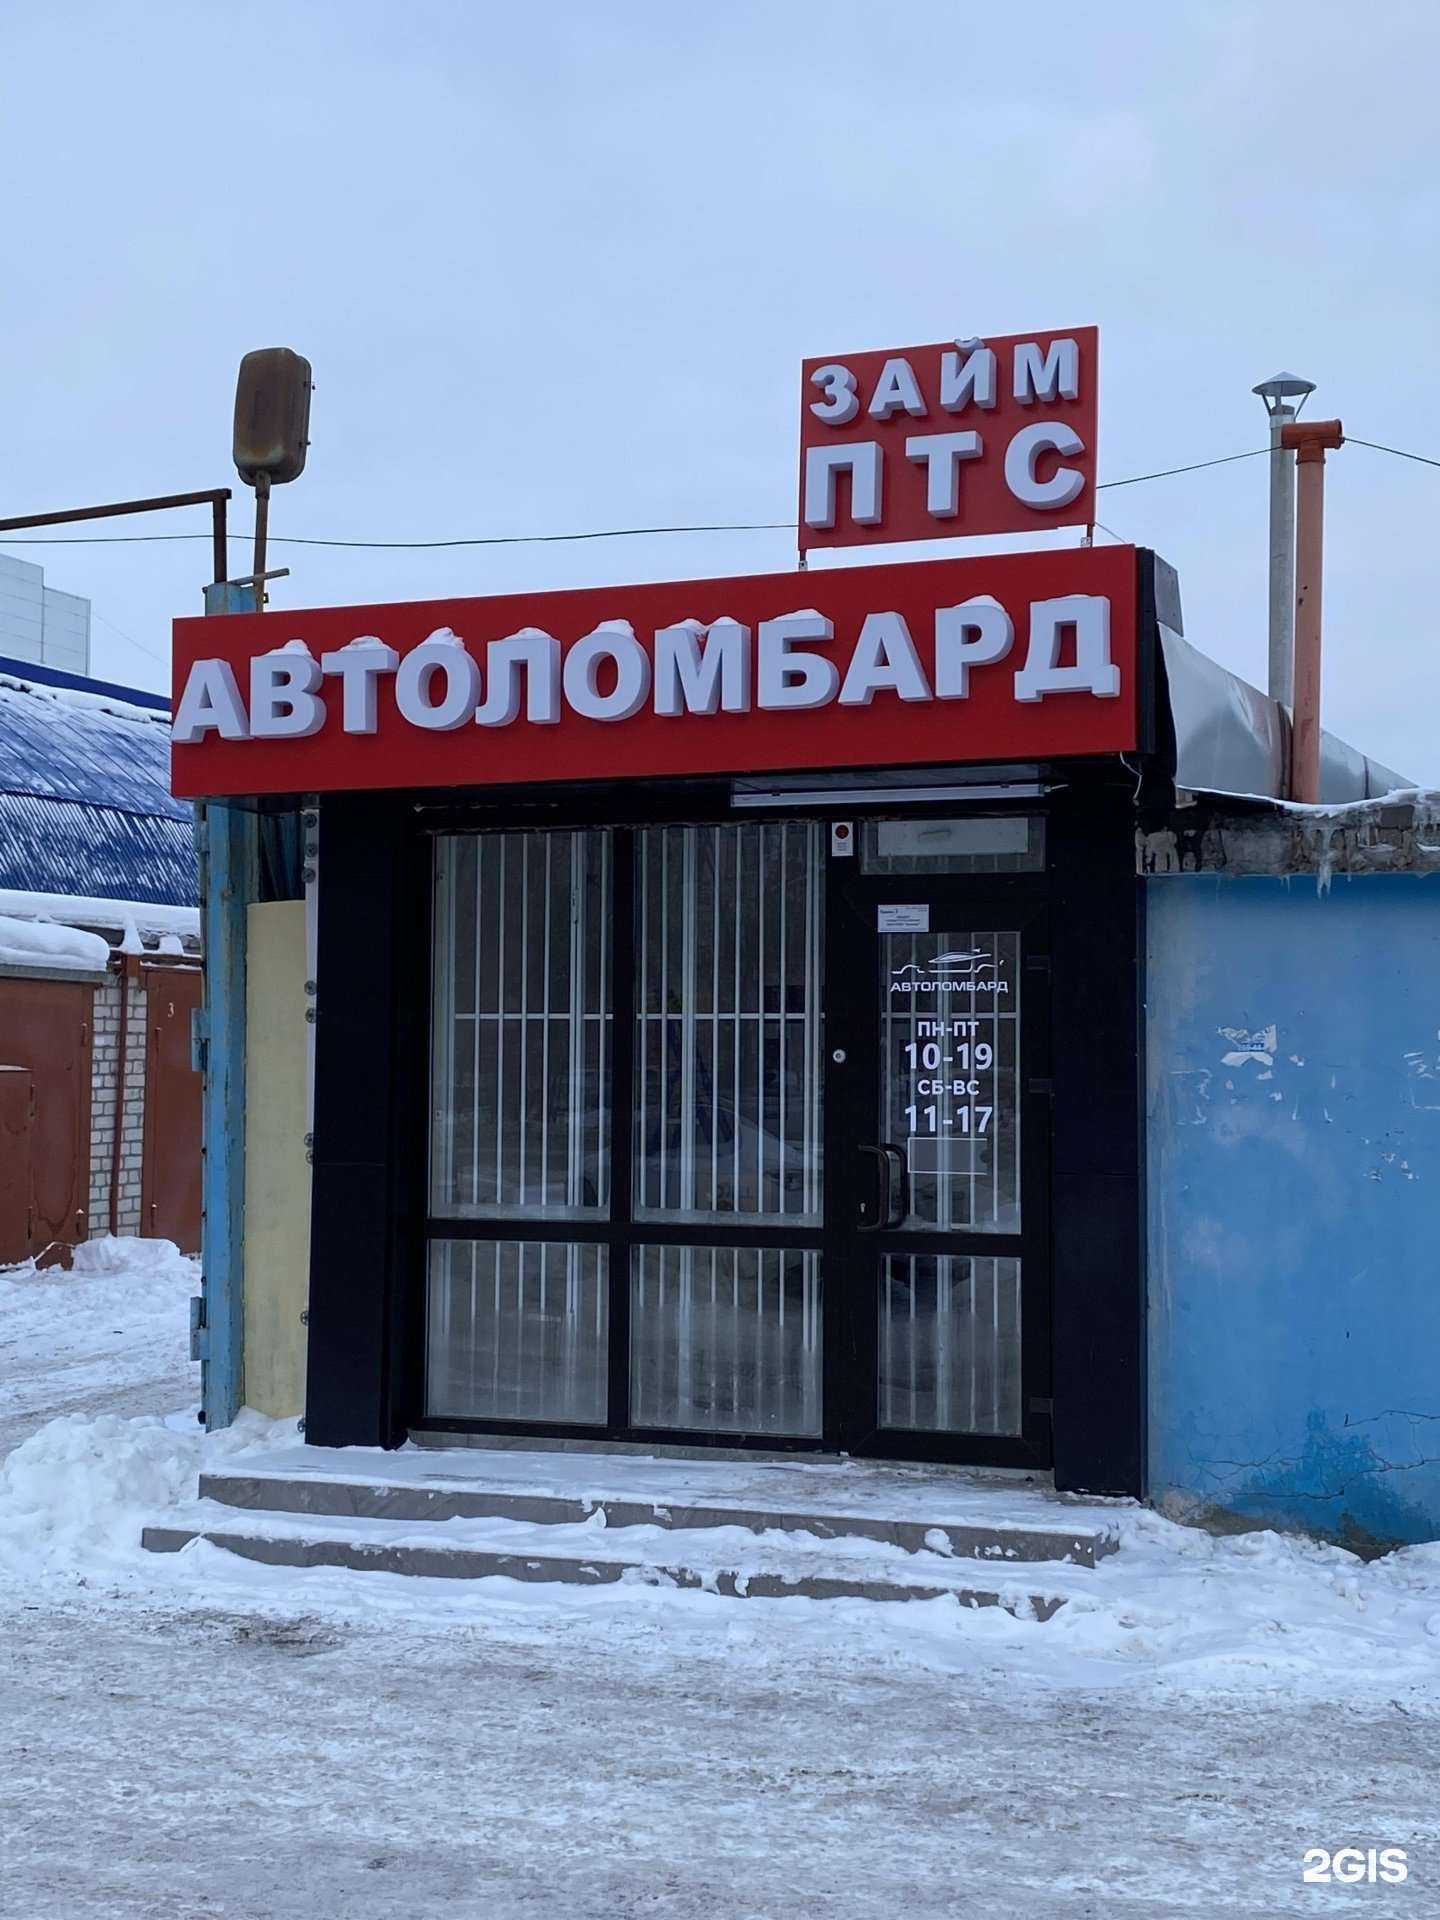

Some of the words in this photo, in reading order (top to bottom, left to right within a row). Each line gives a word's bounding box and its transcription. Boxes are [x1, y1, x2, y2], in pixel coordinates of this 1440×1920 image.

[809, 337, 1078, 425] ЗАЙМ
[804, 421, 1085, 528] ПТС
[171, 594, 1121, 744] АВТОЛОМБАРД
[890, 981, 1009, 993] АВТОЛОМБАРД
[918, 1021, 979, 1037] ПН-ПТ
[904, 1042, 993, 1070] 10-19
[918, 1080, 980, 1096] СБ-ВС
[904, 1105, 993, 1133] 11-17
